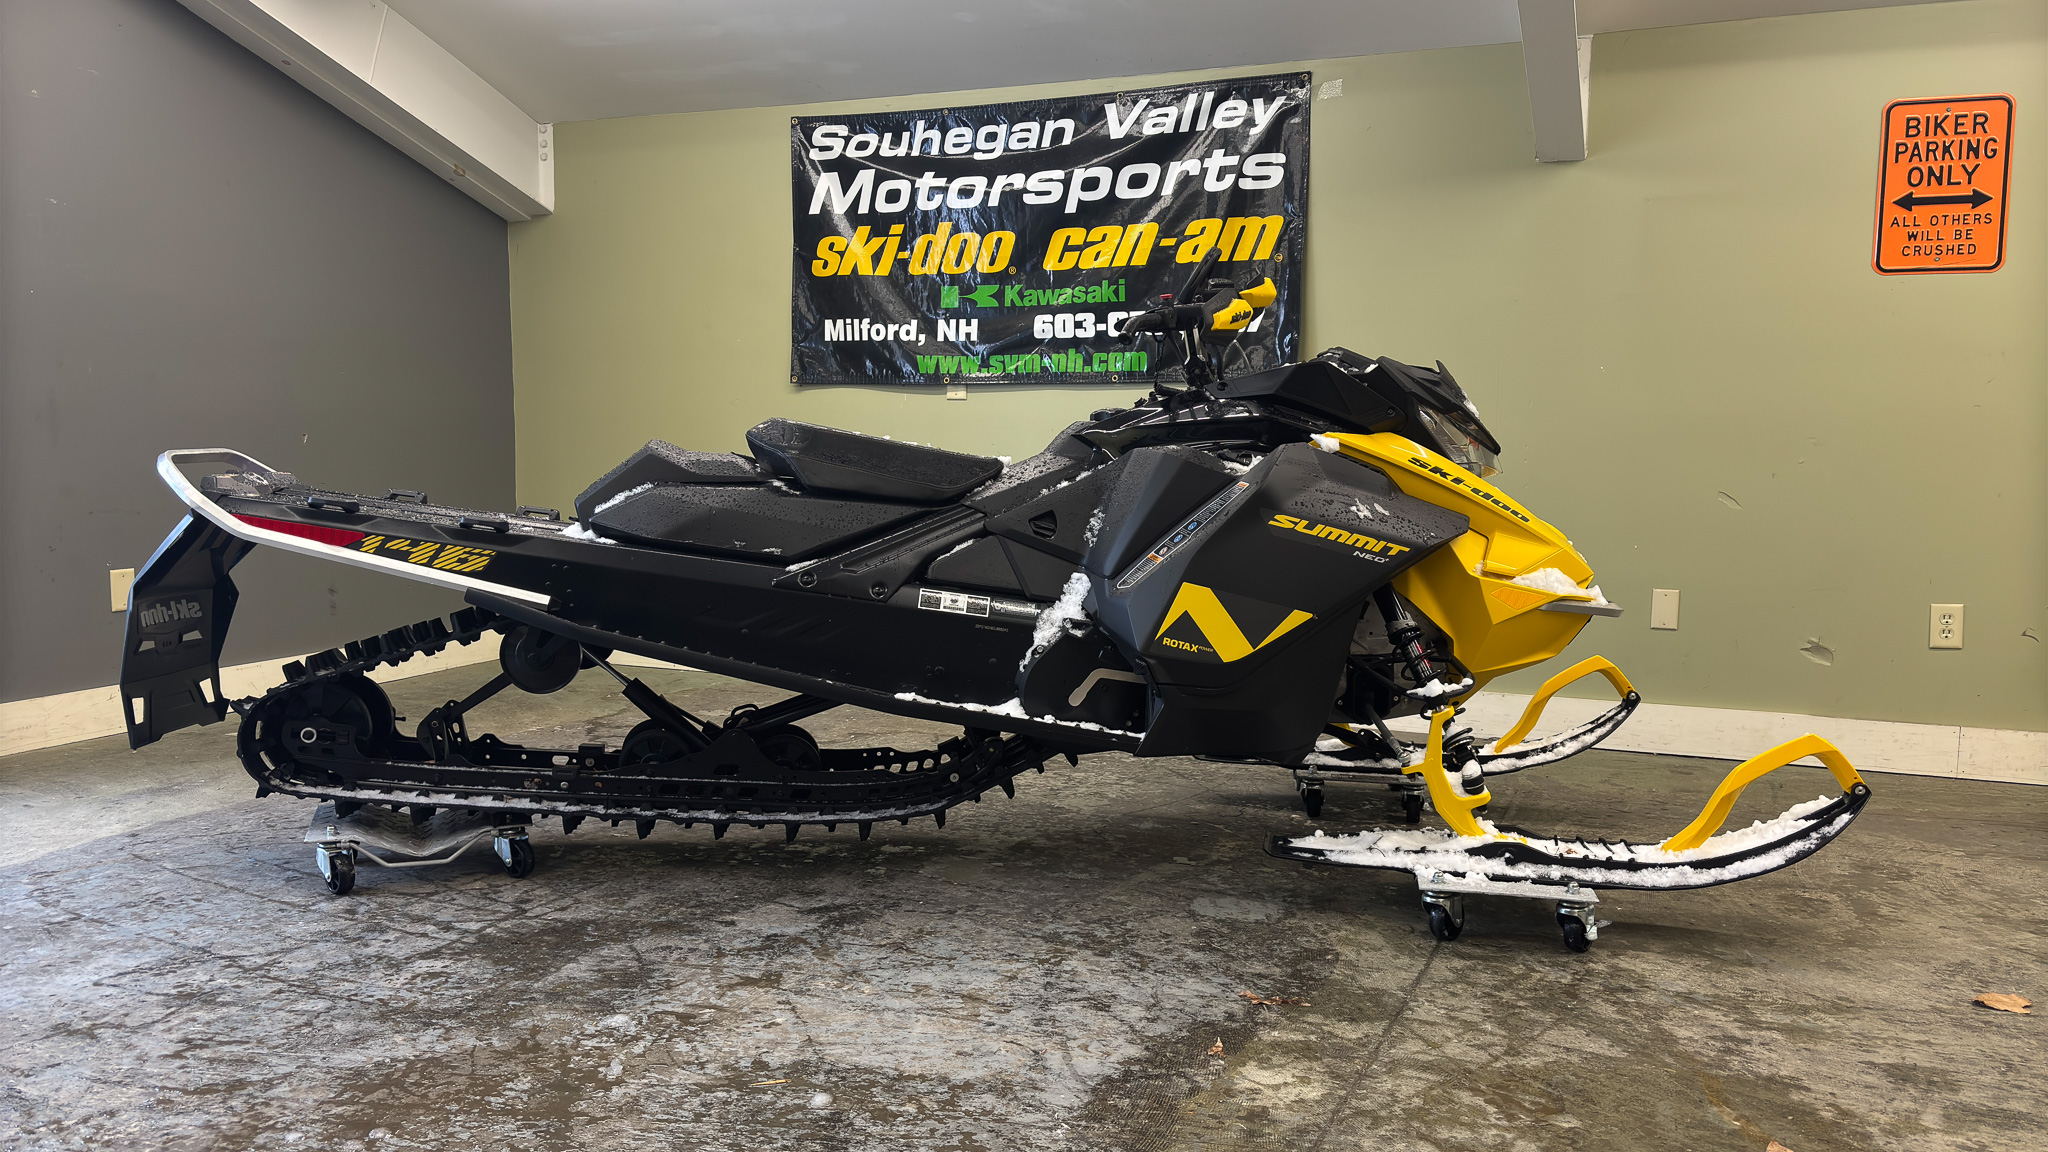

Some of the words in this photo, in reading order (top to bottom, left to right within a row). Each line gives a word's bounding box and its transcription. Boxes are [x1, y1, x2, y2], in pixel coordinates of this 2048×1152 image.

[808, 118, 1075, 162] Souhegan
[1103, 92, 1287, 141] Valley
[1905, 112, 1989, 138] BIKER
[1894, 137, 1999, 163] PARKING
[808, 148, 1287, 215] Motorsports
[1907, 163, 1982, 187] ONLY
[1890, 215, 1921, 228] ALL
[1929, 213, 1993, 227] OTHERS
[811, 221, 1016, 278] ski-doo
[1043, 214, 1285, 271] can-am
[1907, 230, 1945, 242] WILL
[1953, 228, 1974, 241] BE
[1901, 243, 1977, 257] CRUSHED
[1004, 278, 1126, 308] Kawasaki
[824, 318, 925, 346] Milford,
[937, 318, 979, 342] NH
[917, 348, 1147, 375] www.svm-nh.com
[1408, 457, 1530, 523] ski-doo
[1268, 514, 1411, 556] SUMMIT
[1162, 637, 1199, 653] ROTAX
